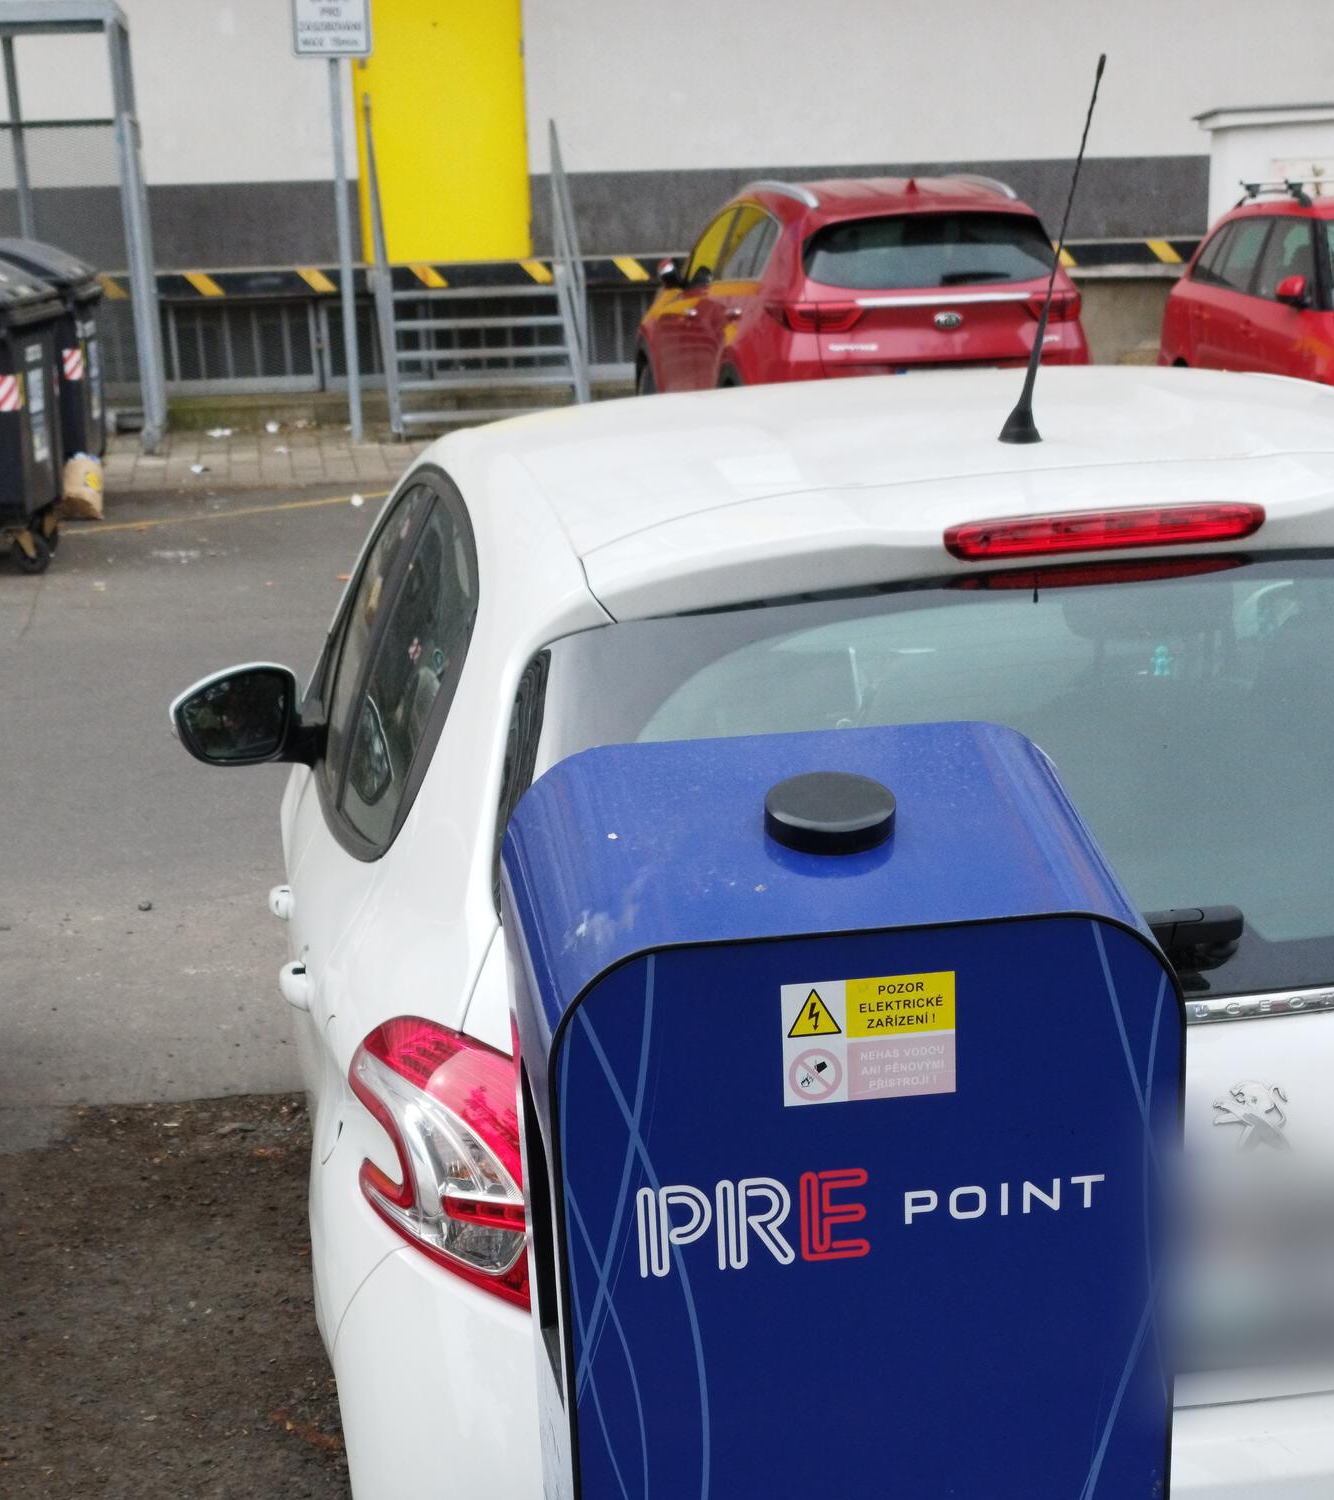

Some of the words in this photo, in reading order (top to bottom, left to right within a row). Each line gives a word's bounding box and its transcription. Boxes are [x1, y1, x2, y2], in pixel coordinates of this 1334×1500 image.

[878, 981, 925, 995] POZOR
[859, 994, 944, 1013] ELEKTRICKÉ
[1194, 992, 1334, 1018] UGEOT
[867, 1012, 929, 1029] ZAŘÍZENÍ
[903, 1044, 945, 1058] VODOU
[860, 1063, 882, 1077] ANI
[636, 1168, 870, 1278] PRE
[904, 1174, 1105, 1225] POINT
